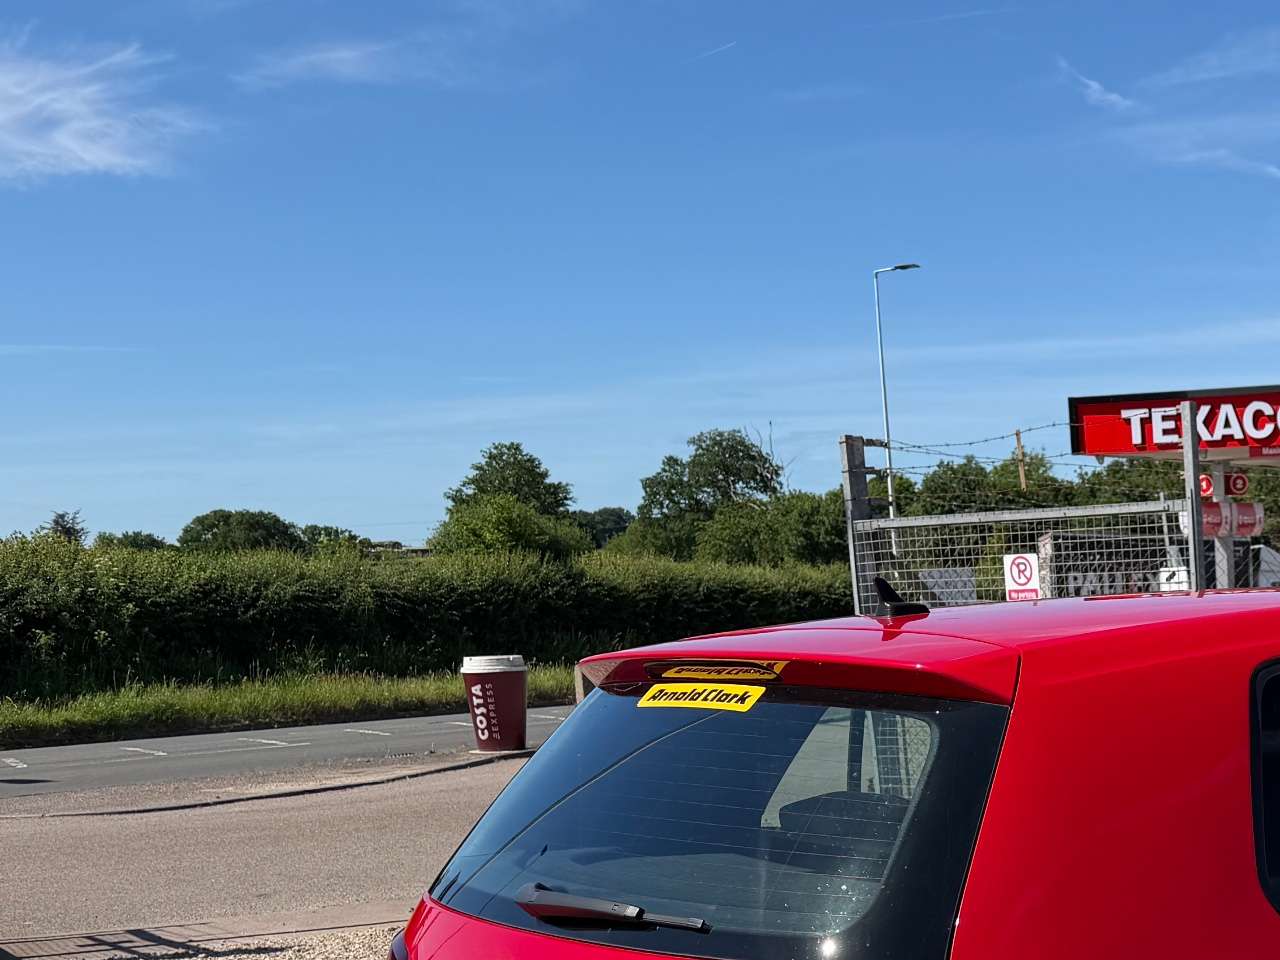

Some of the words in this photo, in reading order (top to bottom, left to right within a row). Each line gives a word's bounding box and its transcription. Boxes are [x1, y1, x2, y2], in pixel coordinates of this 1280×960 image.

[471, 683, 489, 741] COSTA
[486, 683, 499, 732] EXPRESS
[647, 688, 705, 702] Arnold
[700, 689, 753, 705] Clark
